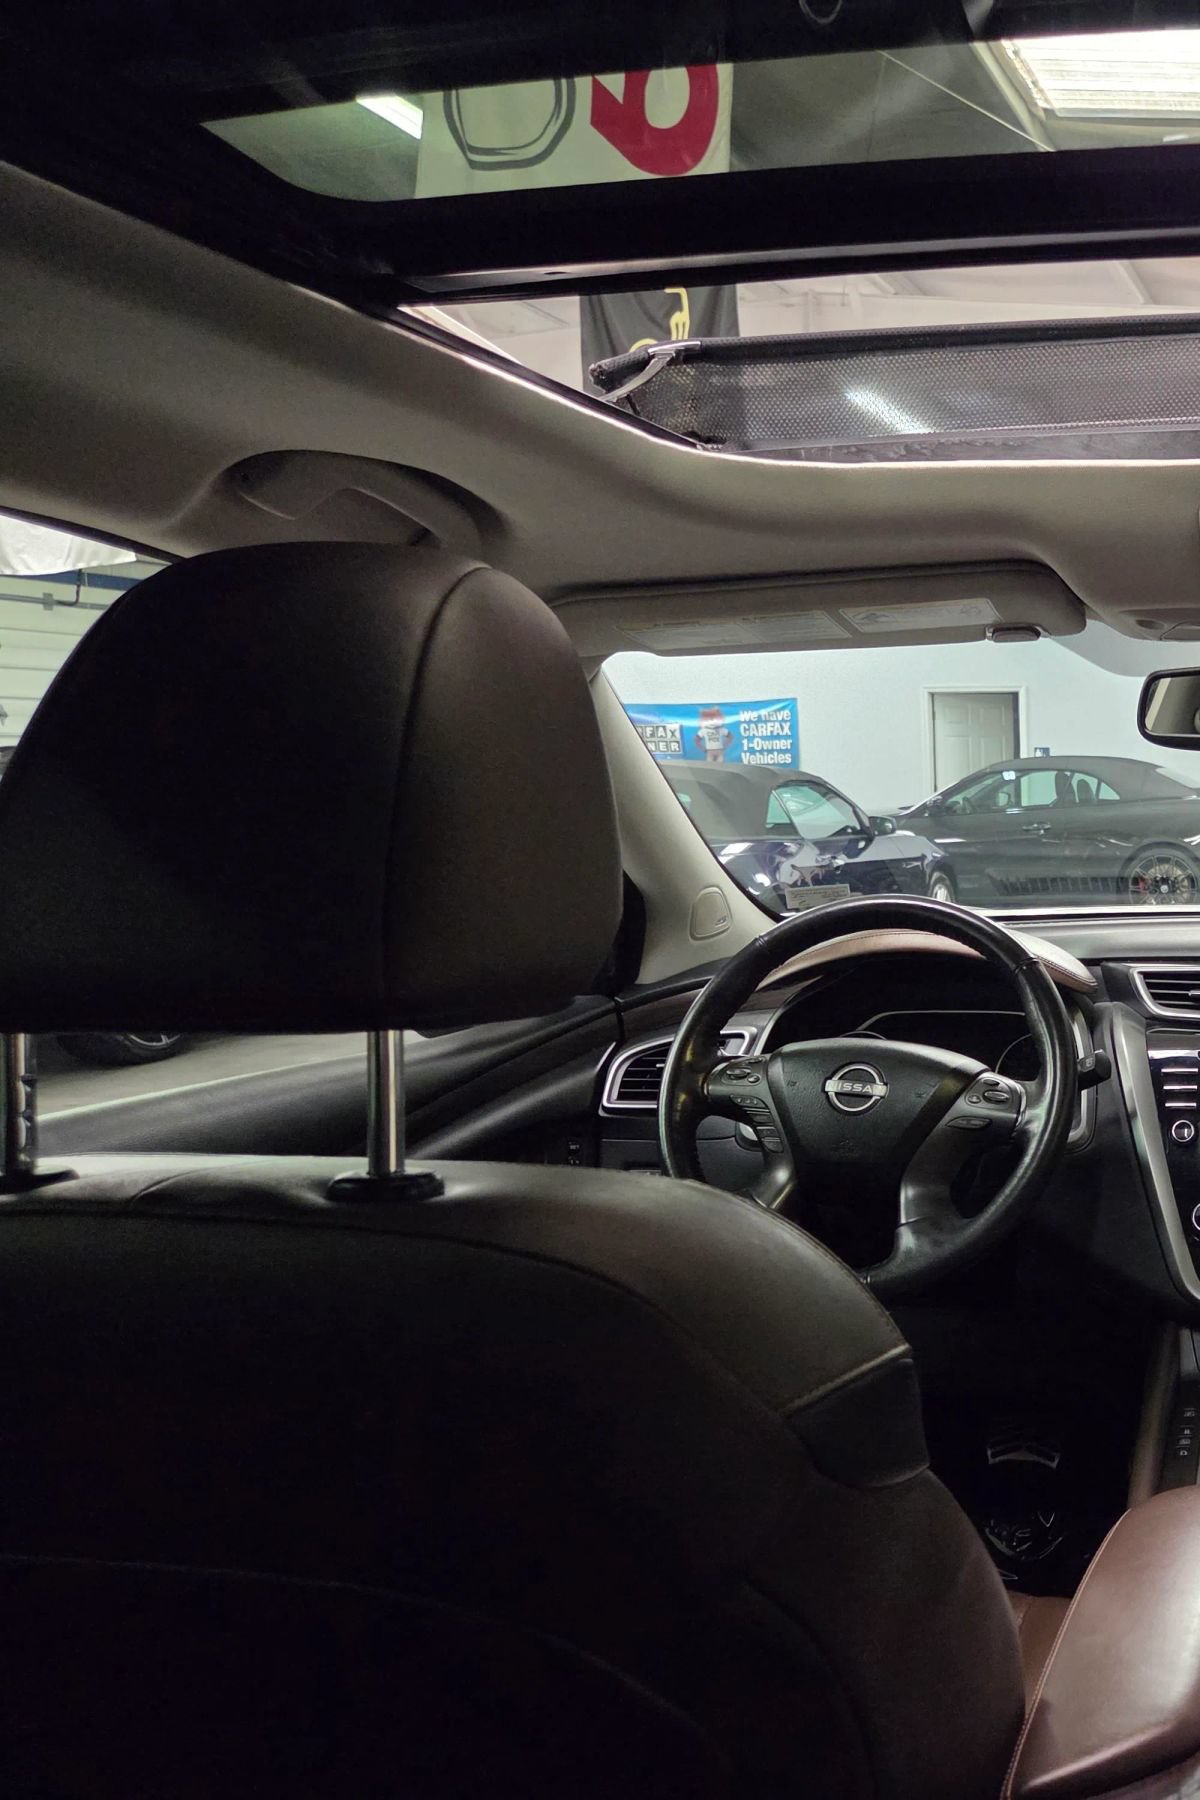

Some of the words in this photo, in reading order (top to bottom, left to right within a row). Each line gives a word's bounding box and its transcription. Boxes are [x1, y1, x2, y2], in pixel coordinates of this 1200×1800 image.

[739, 710, 757, 721] We
[740, 722, 792, 736] CARFAX
[741, 738, 792, 750] 1-Owner
[741, 752, 792, 764] Vehicles
